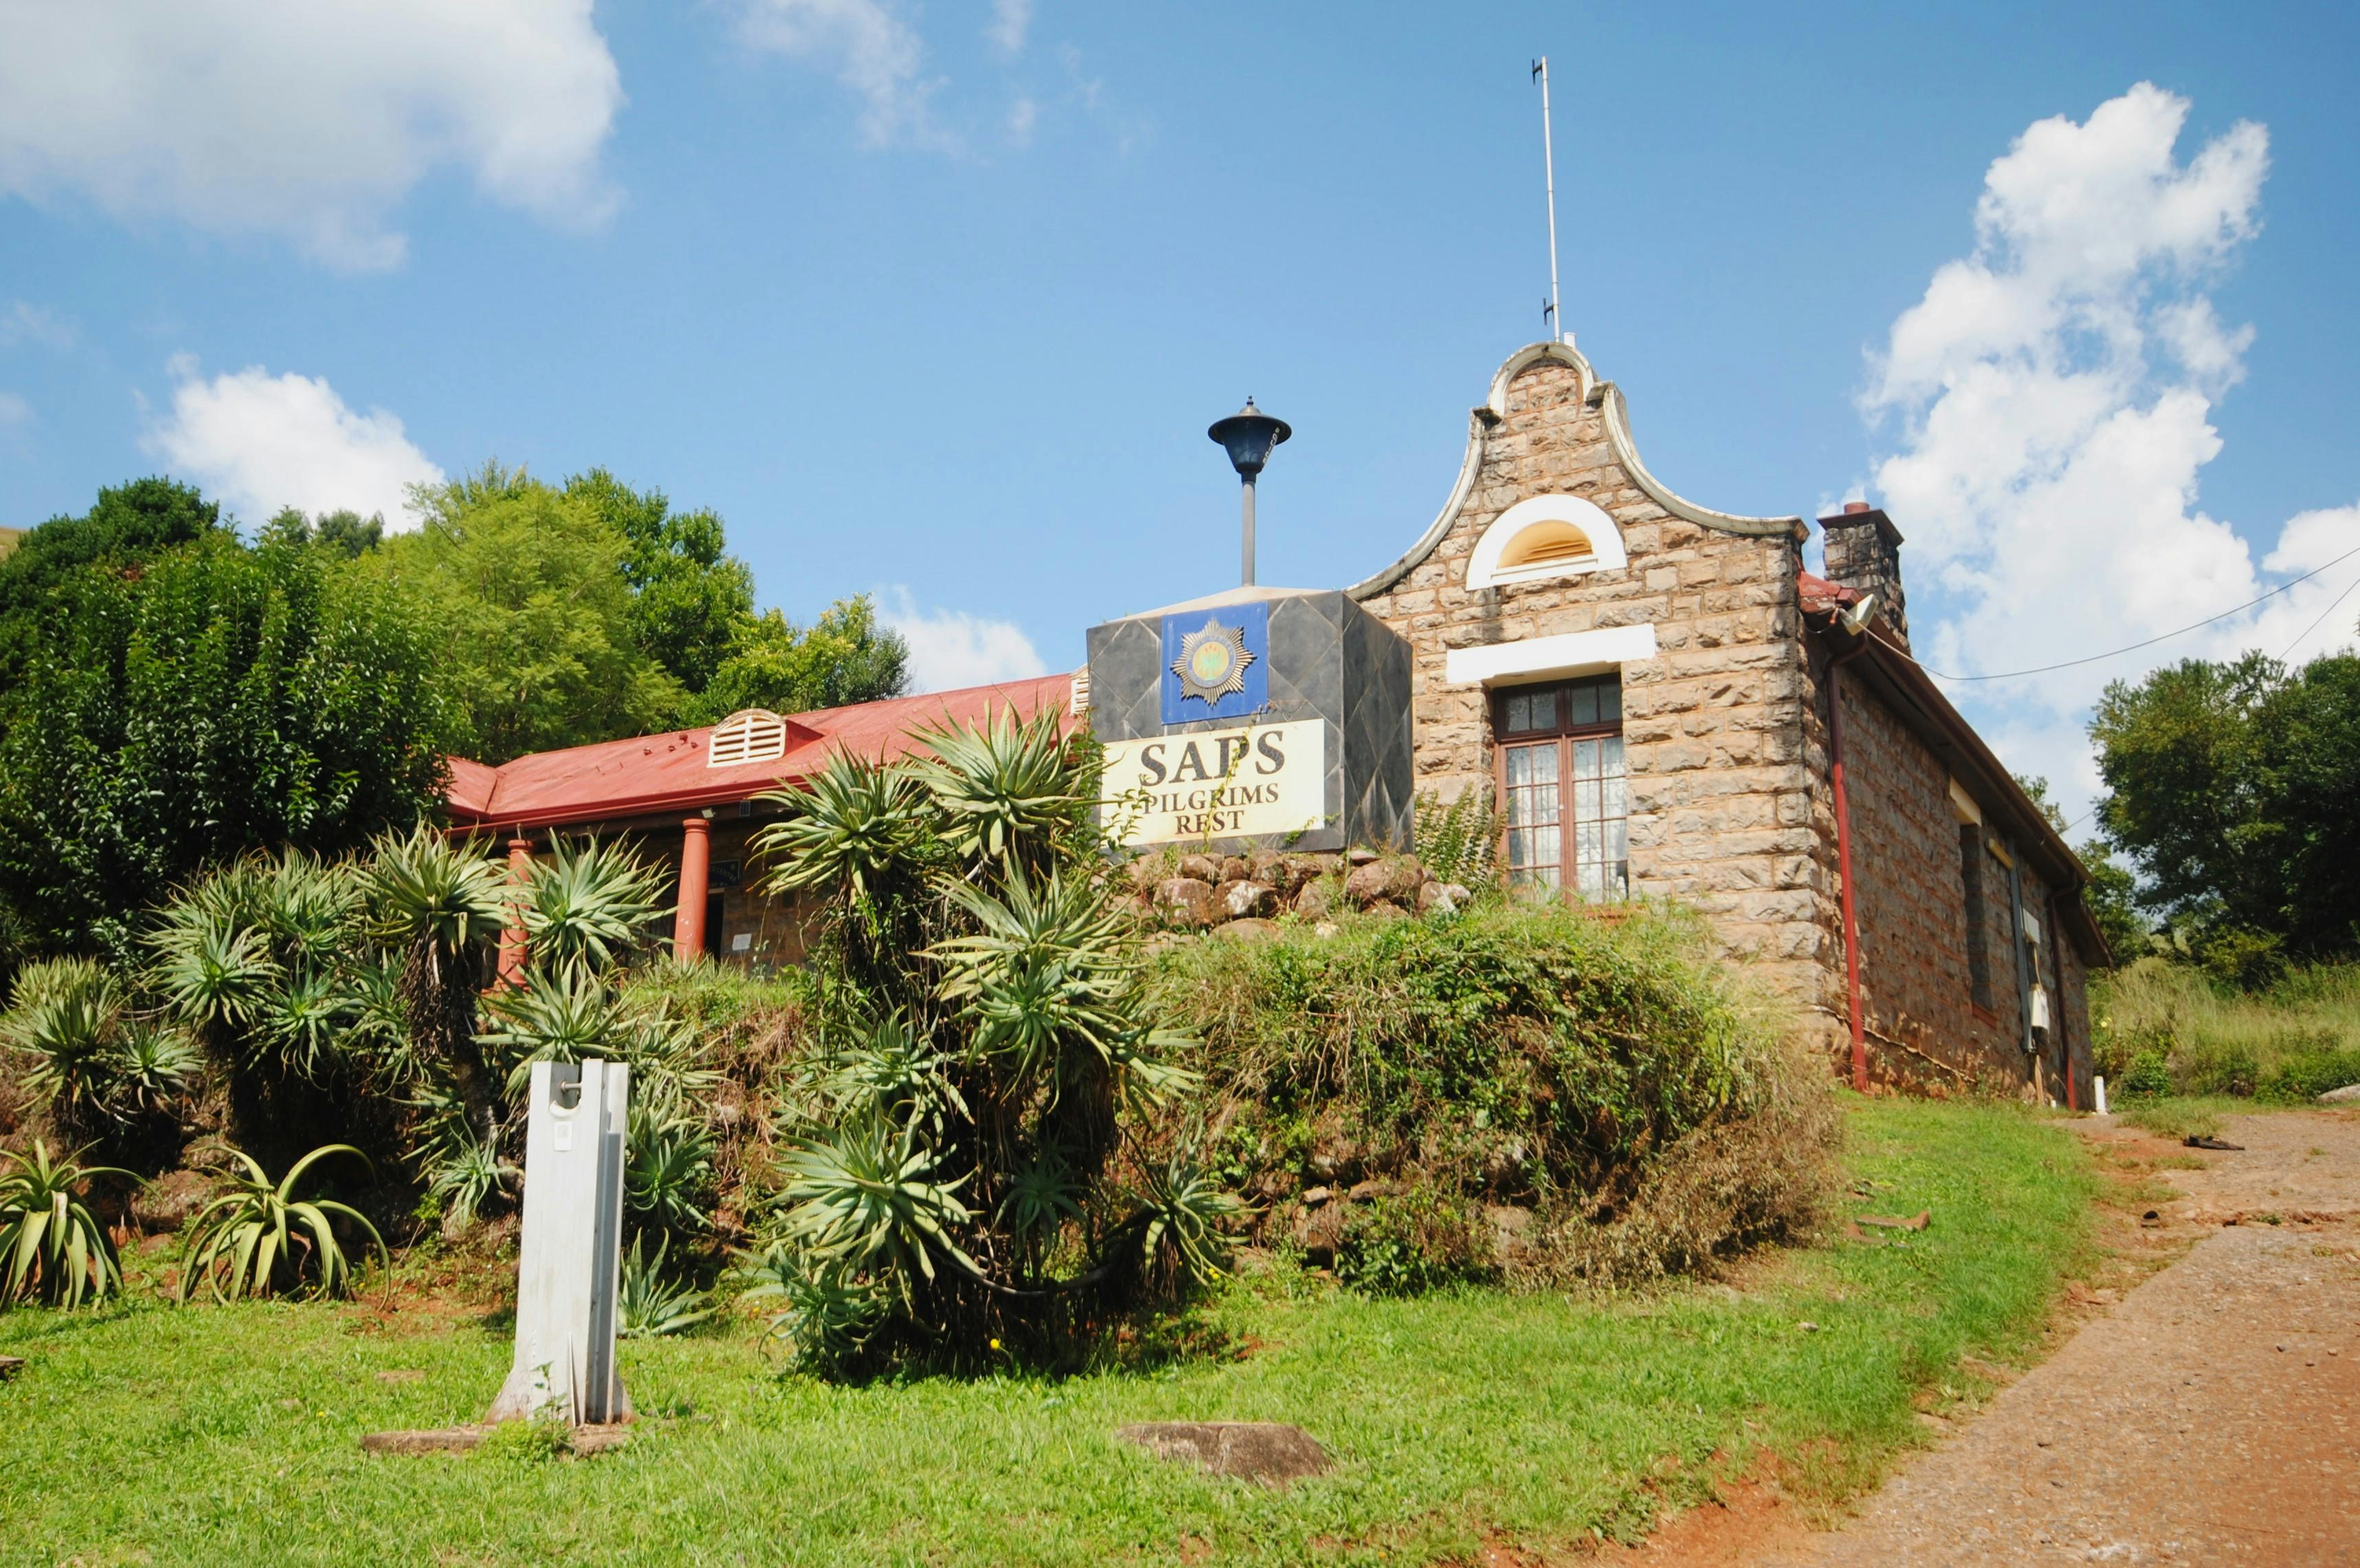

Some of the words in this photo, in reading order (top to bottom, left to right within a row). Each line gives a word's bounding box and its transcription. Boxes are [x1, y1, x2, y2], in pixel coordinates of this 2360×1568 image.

[1140, 730, 1285, 787] SAPS
[1142, 783, 1279, 814] PILGRIMS
[1175, 810, 1245, 835] REST
